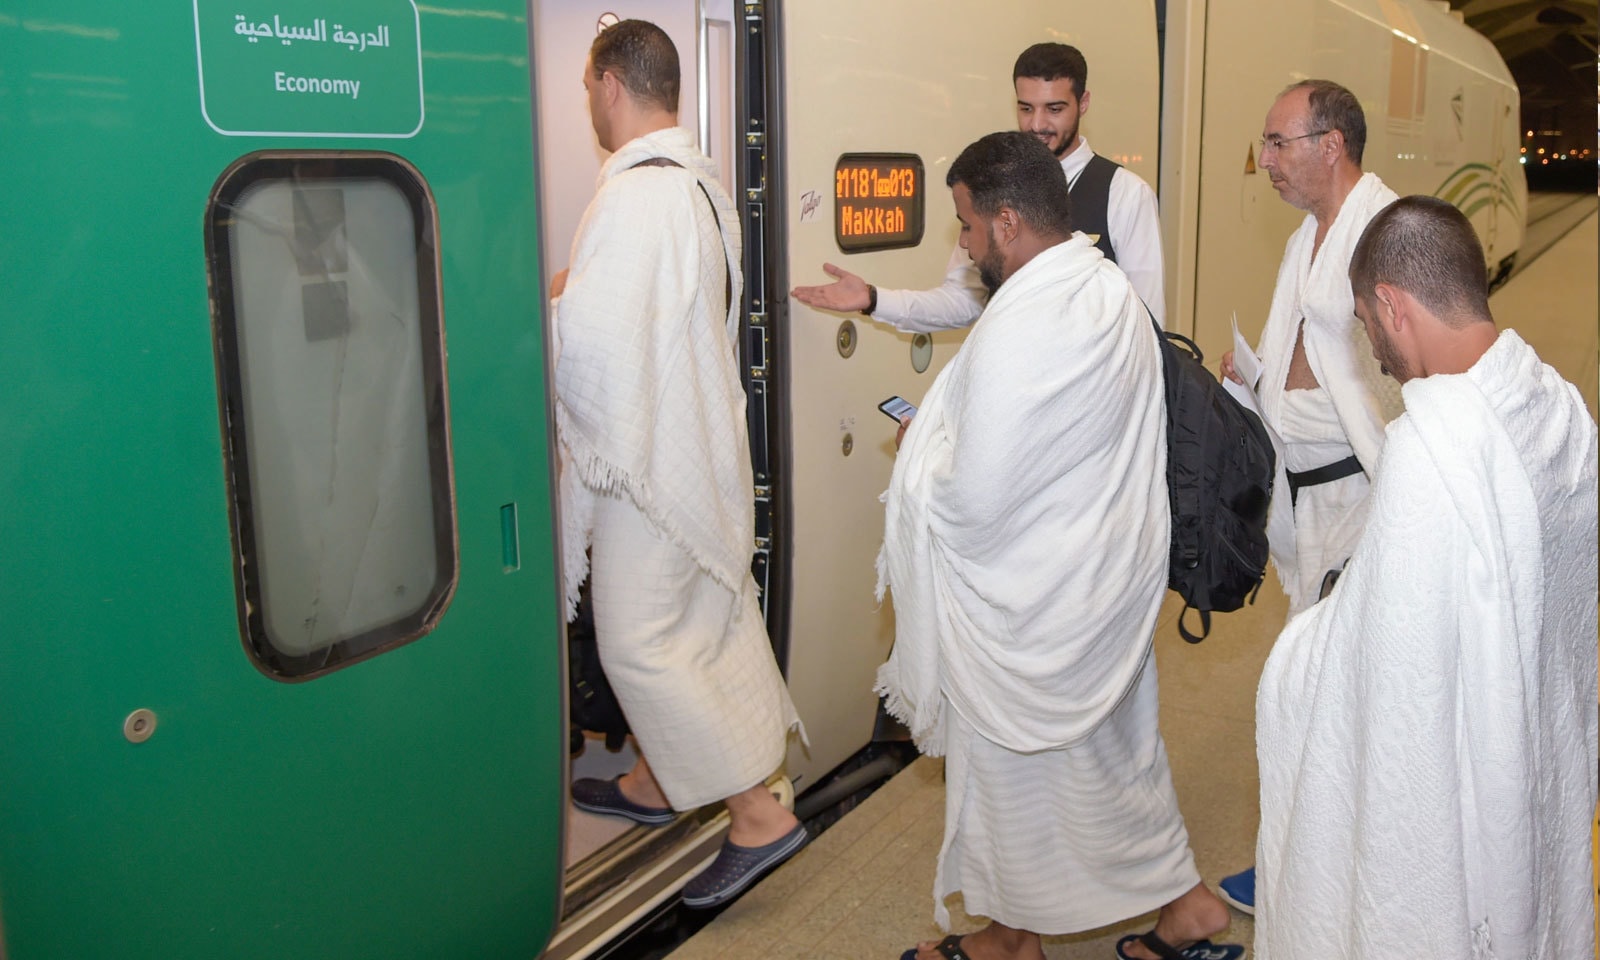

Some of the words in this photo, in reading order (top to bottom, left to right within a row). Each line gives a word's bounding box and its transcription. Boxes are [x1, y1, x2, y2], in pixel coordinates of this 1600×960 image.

[234, 14, 327, 46] السياحية
[332, 23, 390, 52] الدرجة
[274, 71, 361, 100] Economy
[841, 206, 904, 236] Makkah
